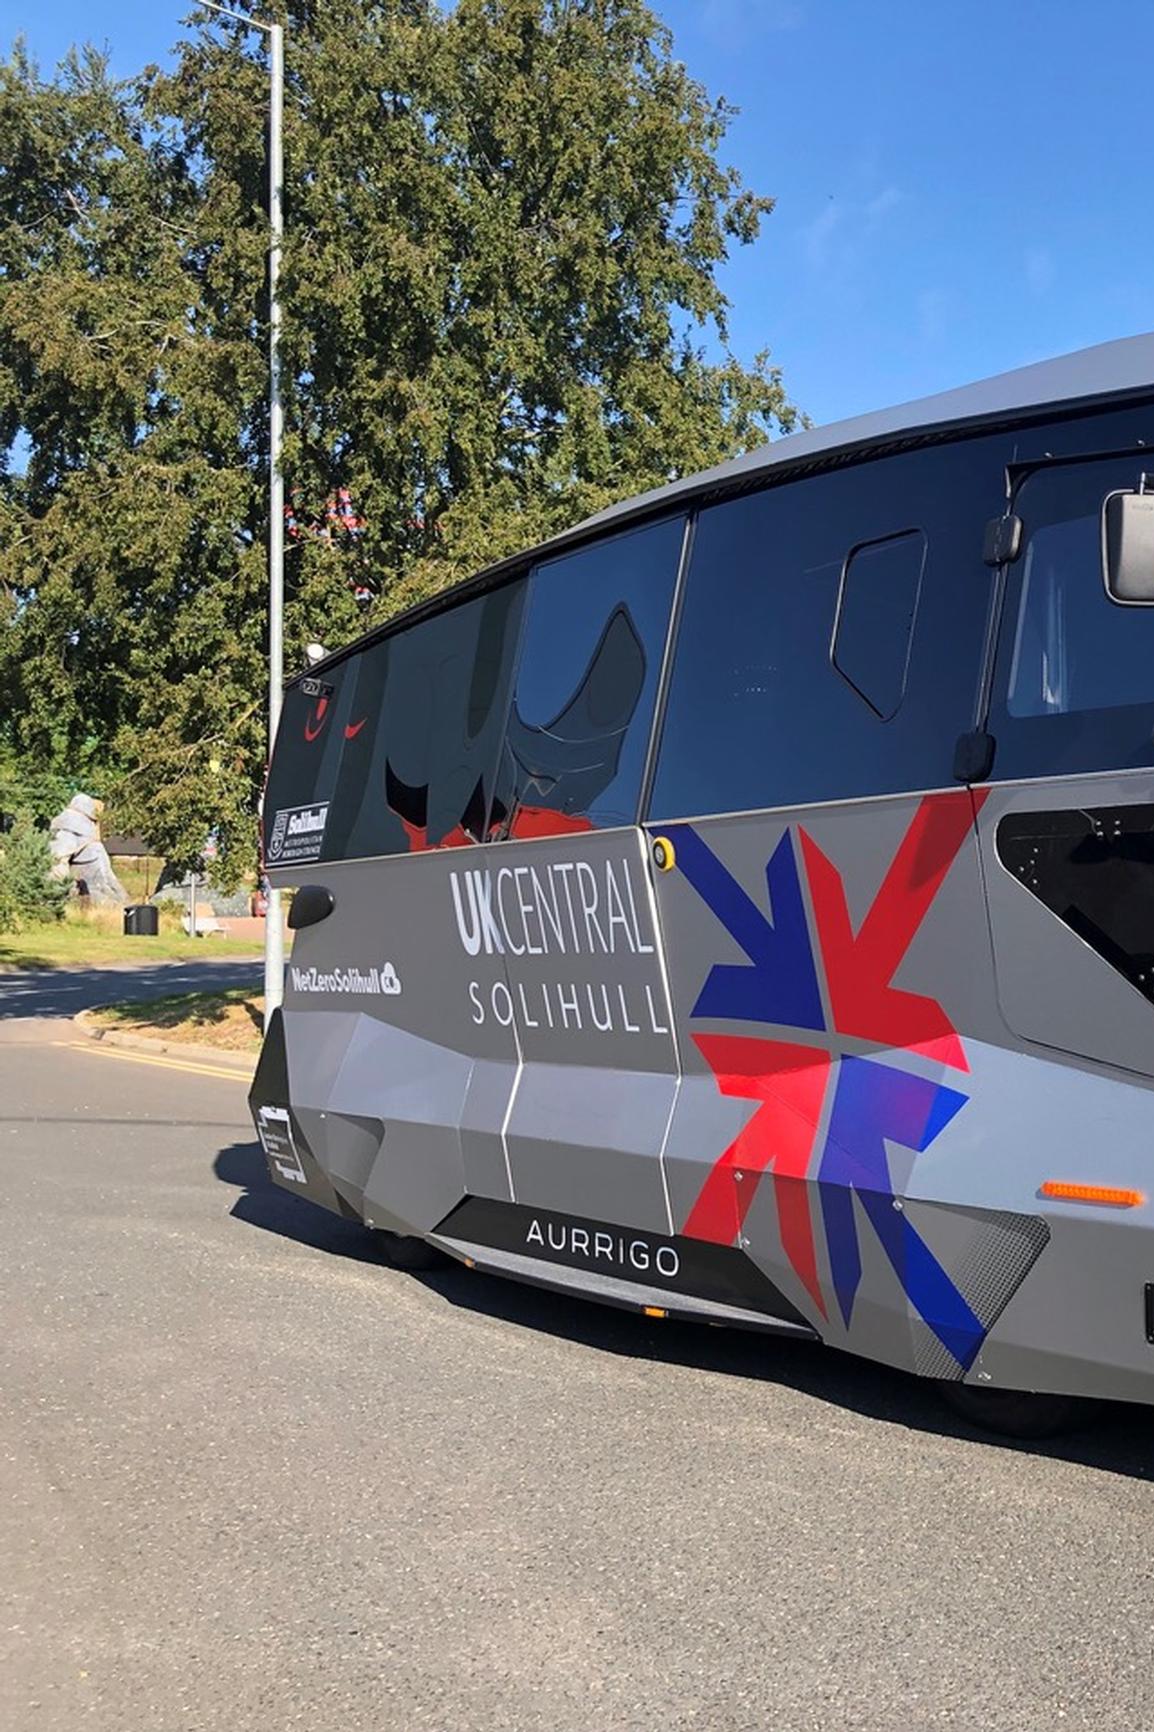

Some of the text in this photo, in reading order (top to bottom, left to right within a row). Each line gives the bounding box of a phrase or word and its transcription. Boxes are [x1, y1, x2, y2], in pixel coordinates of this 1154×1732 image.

[291, 966, 381, 994] NetZeroSolihull
[469, 981, 668, 1034] SOLIHULL
[526, 1219, 679, 1277] AURRIGO
